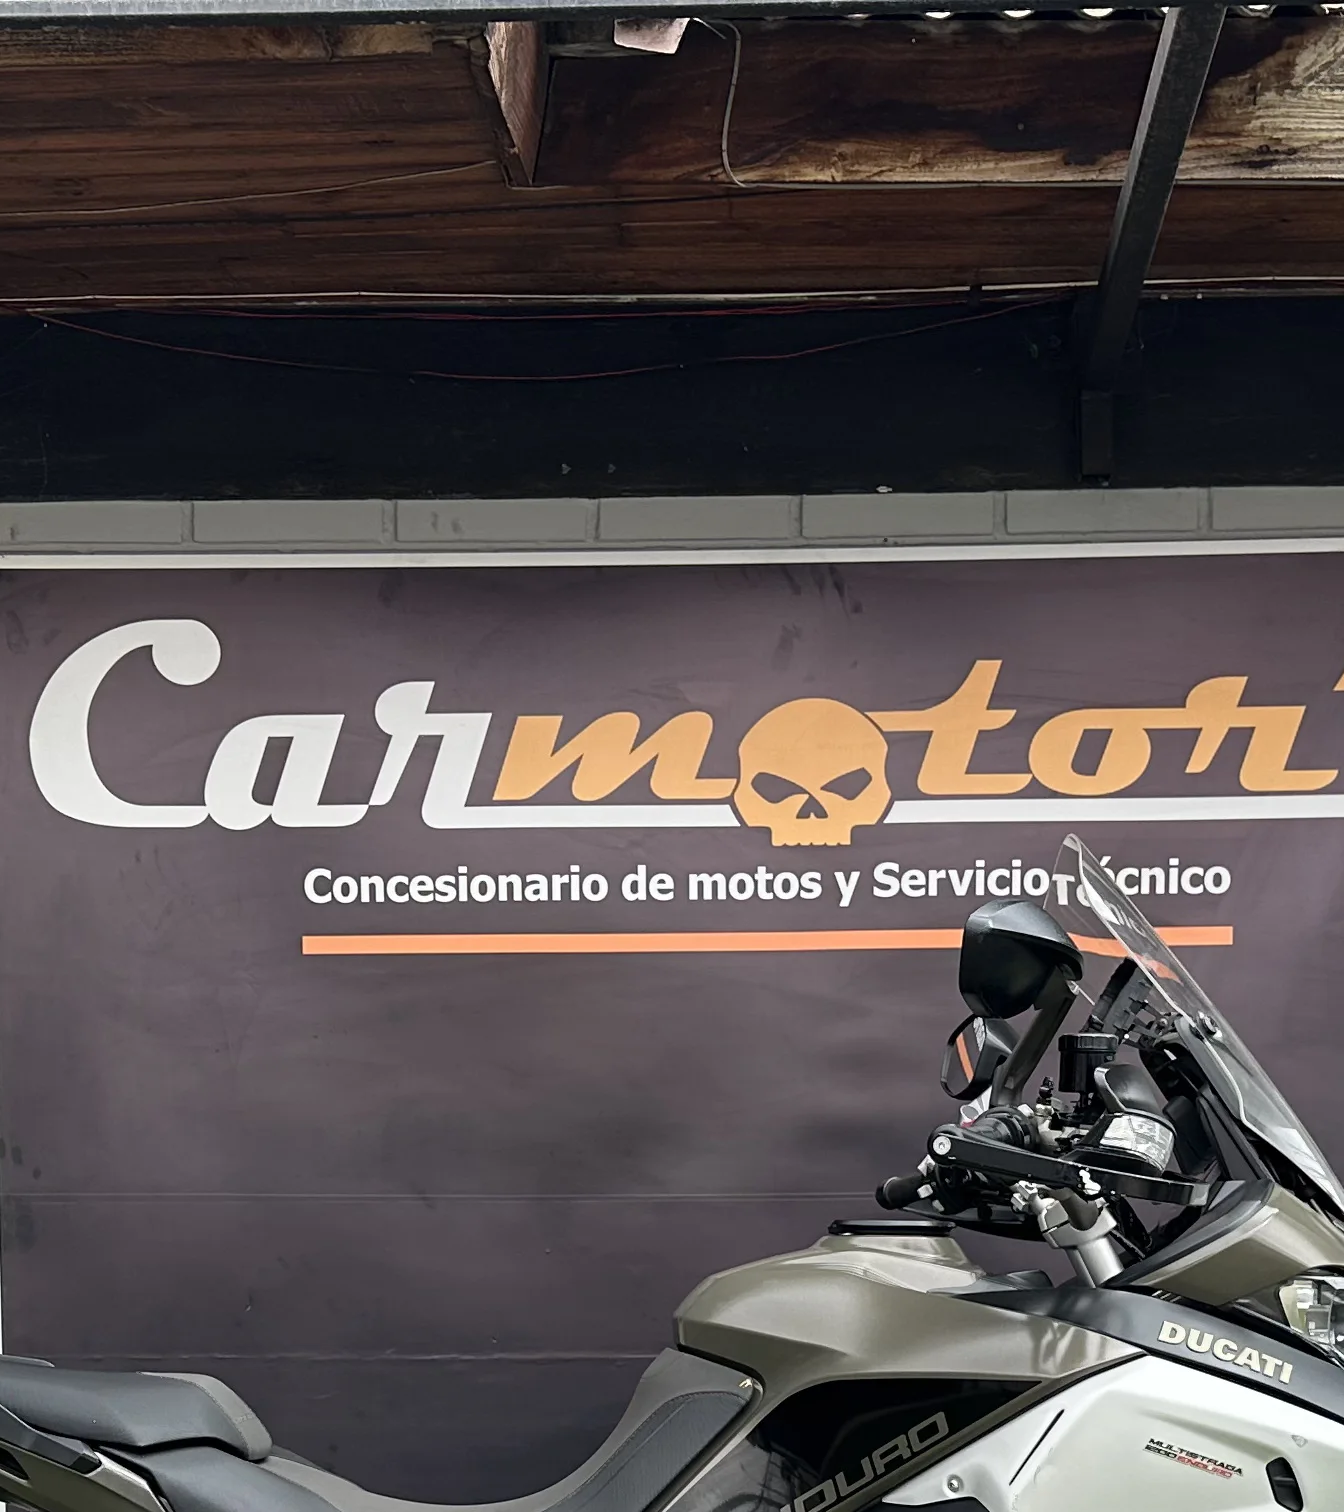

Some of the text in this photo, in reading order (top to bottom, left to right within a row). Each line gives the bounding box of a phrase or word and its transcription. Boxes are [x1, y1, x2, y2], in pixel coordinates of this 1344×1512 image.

[304, 864, 609, 904] Concesionario
[621, 864, 675, 902] de
[688, 866, 822, 901] motos
[833, 871, 860, 907] y
[873, 859, 1049, 897] Servicio
[1157, 1320, 1294, 1385] DUCATI
[1148, 1438, 1244, 1475] MULTISTRADA
